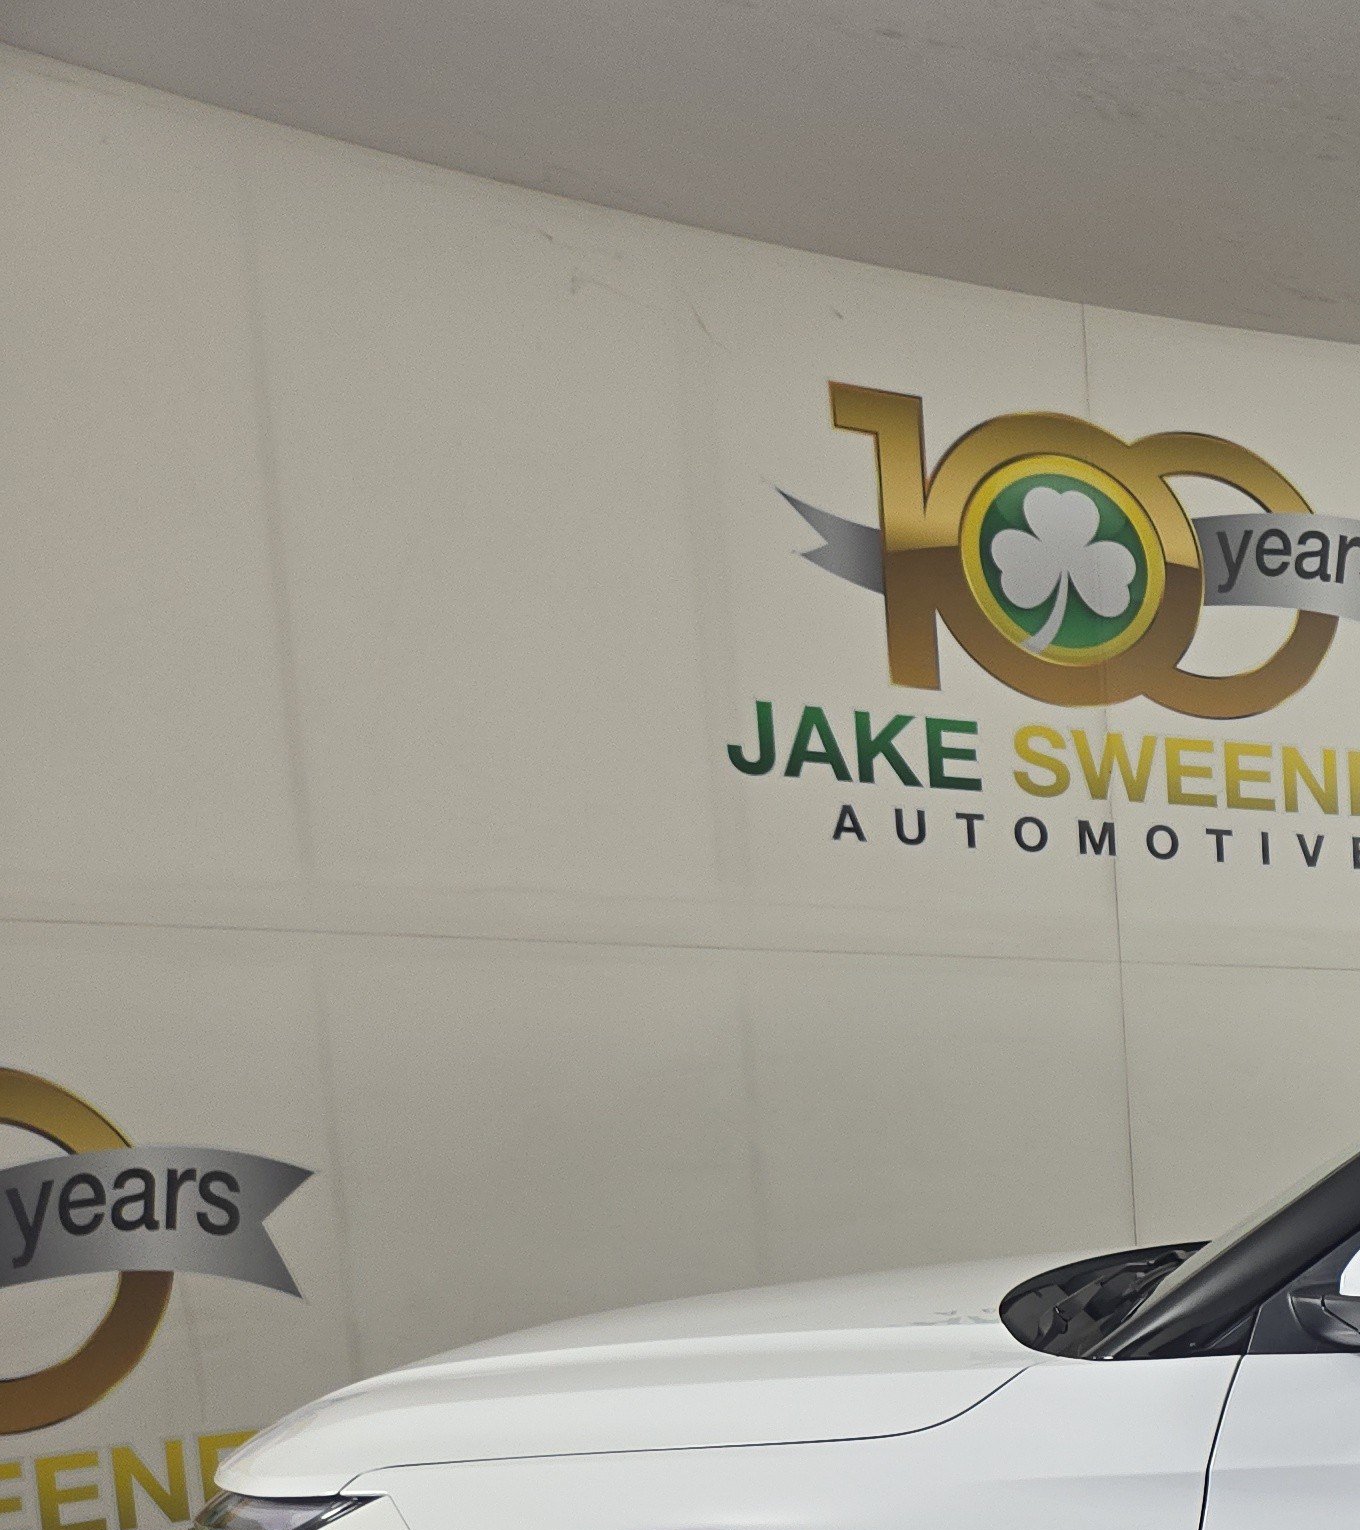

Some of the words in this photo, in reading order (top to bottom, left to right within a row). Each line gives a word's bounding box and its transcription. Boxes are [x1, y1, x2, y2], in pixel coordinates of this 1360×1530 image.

[828, 380, 1339, 720] 100
[726, 700, 983, 792] JAKE
[5, 1167, 241, 1267] years
